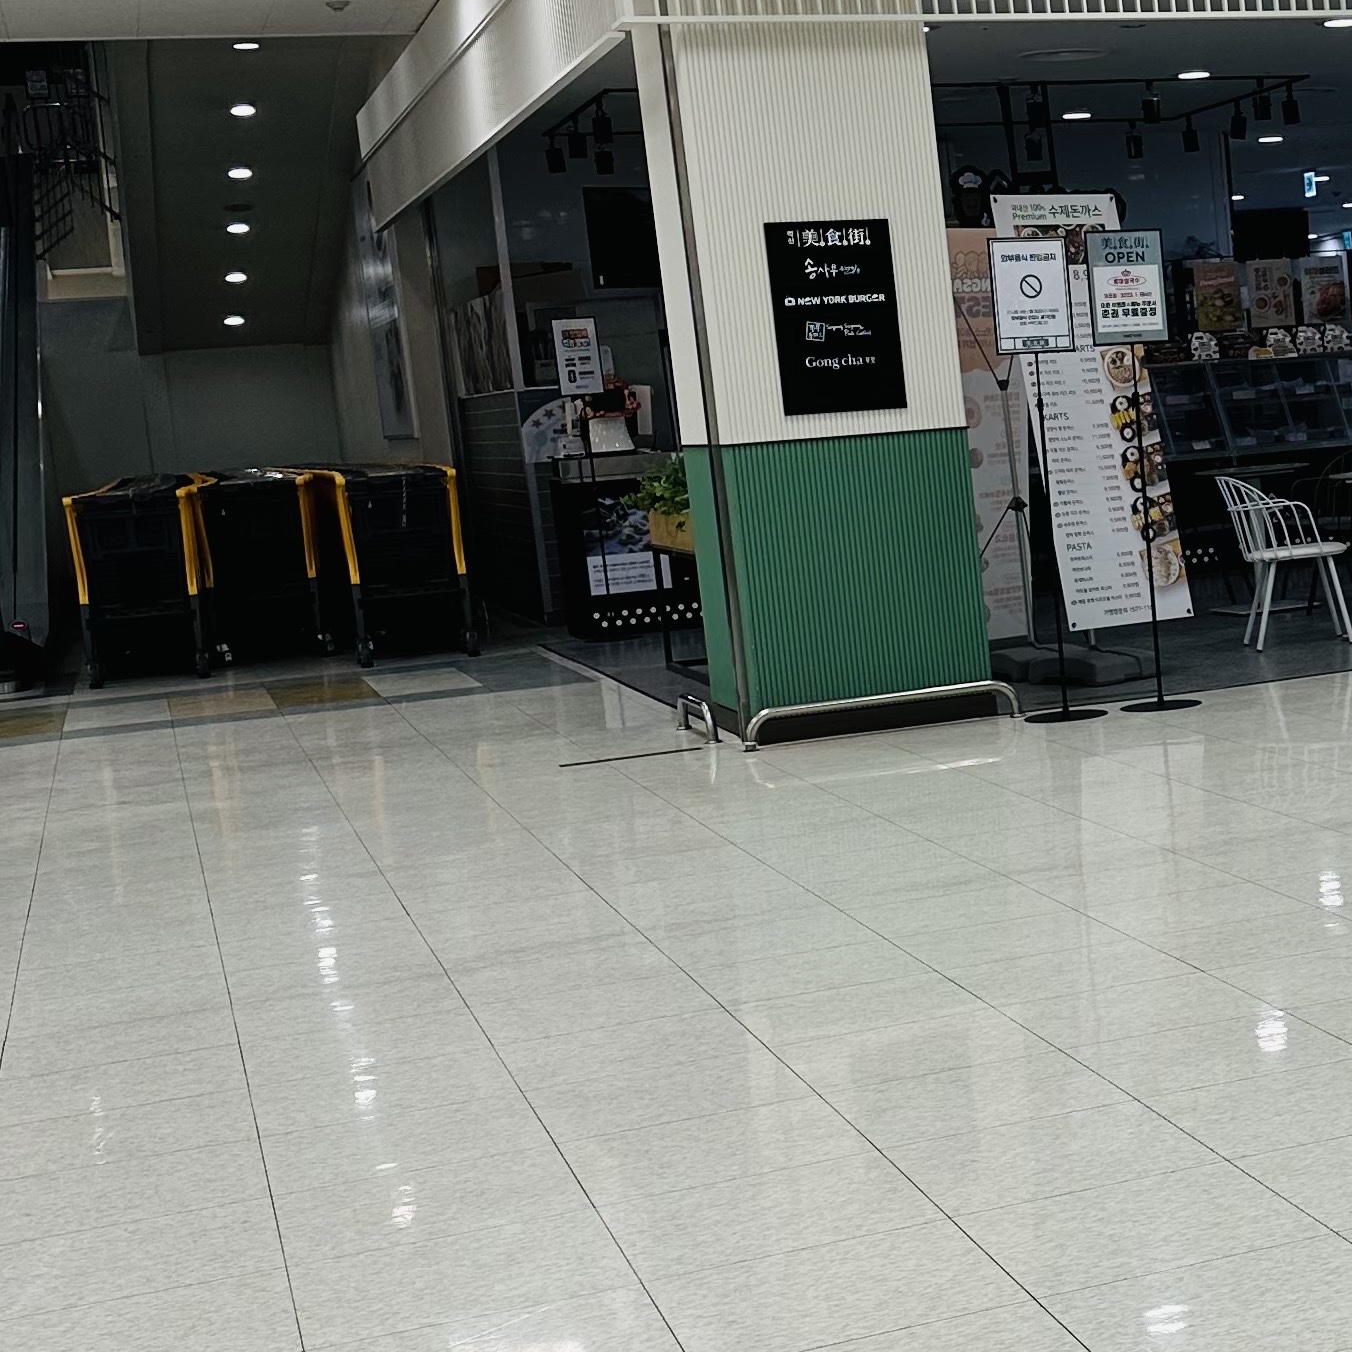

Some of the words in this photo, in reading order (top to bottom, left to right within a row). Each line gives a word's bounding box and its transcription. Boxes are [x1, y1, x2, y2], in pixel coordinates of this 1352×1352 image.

[1012, 213, 1048, 221] Premium
[1048, 204, 1103, 219] 수제돈까스
[1104, 250, 1146, 264] OPEN
[797, 296, 821, 306] NEW
[822, 295, 848, 305] YORK
[847, 293, 886, 304] BURGER
[805, 355, 840, 370] Gong
[841, 353, 864, 366] cha
[1066, 542, 1092, 552] PASTA
